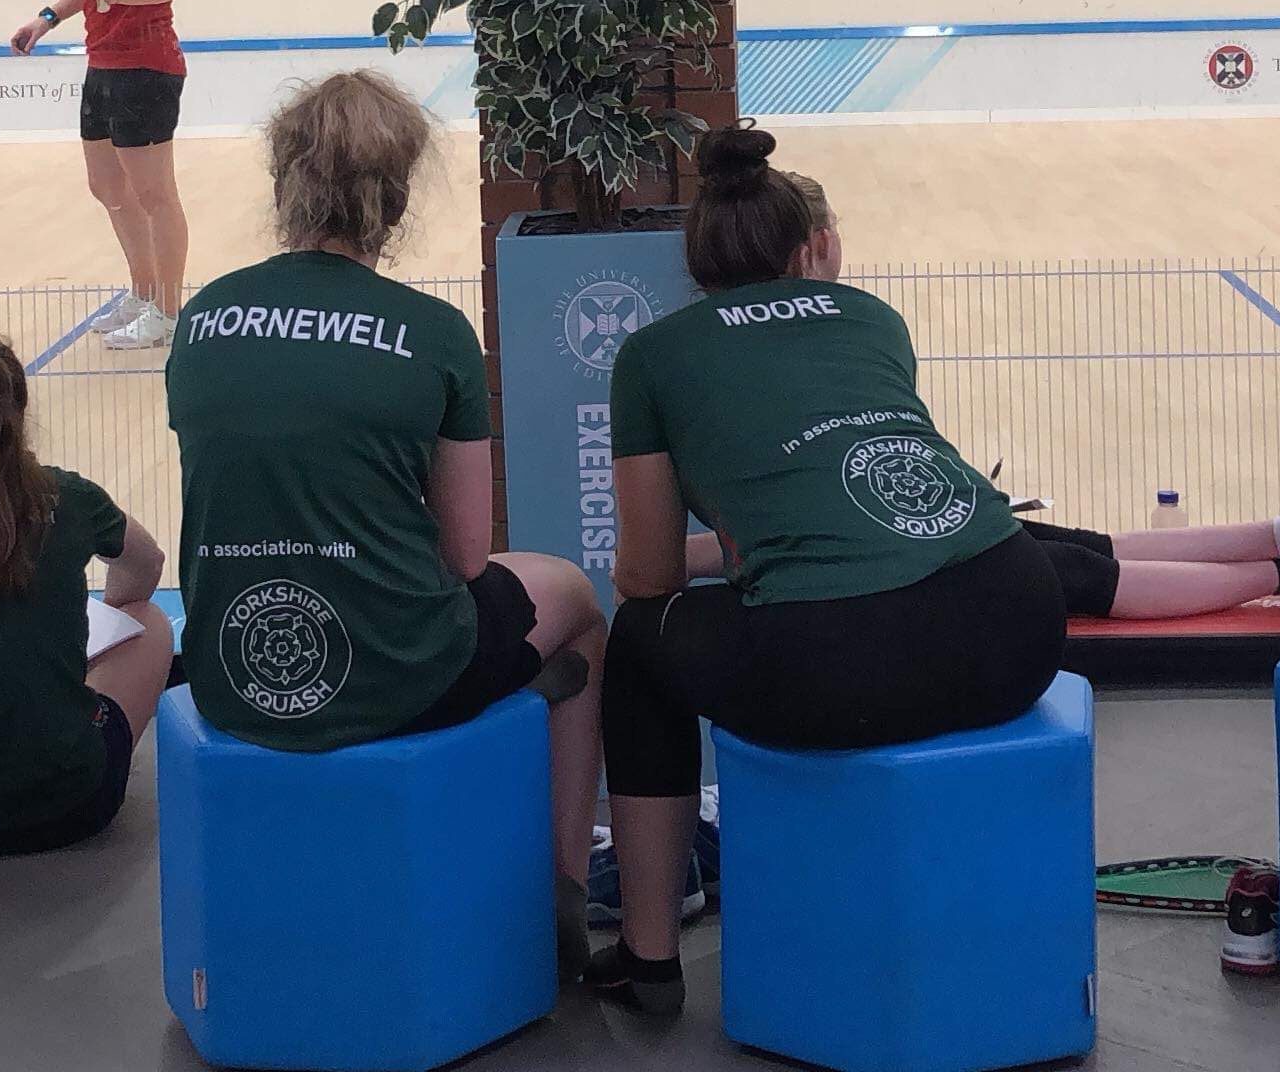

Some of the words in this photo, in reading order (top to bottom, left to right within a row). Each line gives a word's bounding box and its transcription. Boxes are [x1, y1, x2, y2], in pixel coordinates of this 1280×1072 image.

[51, 83, 65, 103] of
[552, 288, 573, 320] THE
[575, 269, 666, 316] UNIVERSITY
[716, 293, 843, 328] MOORE
[188, 304, 414, 359] THORNEWELL
[802, 410, 897, 442] association
[849, 439, 936, 481] YORKSHIRE
[576, 403, 617, 570] EXERCISE
[893, 498, 971, 536] SQUASH
[214, 539, 315, 558] association
[318, 541, 357, 559] with
[227, 586, 333, 630] YORKSHIRE
[242, 679, 334, 713] SQUASH
